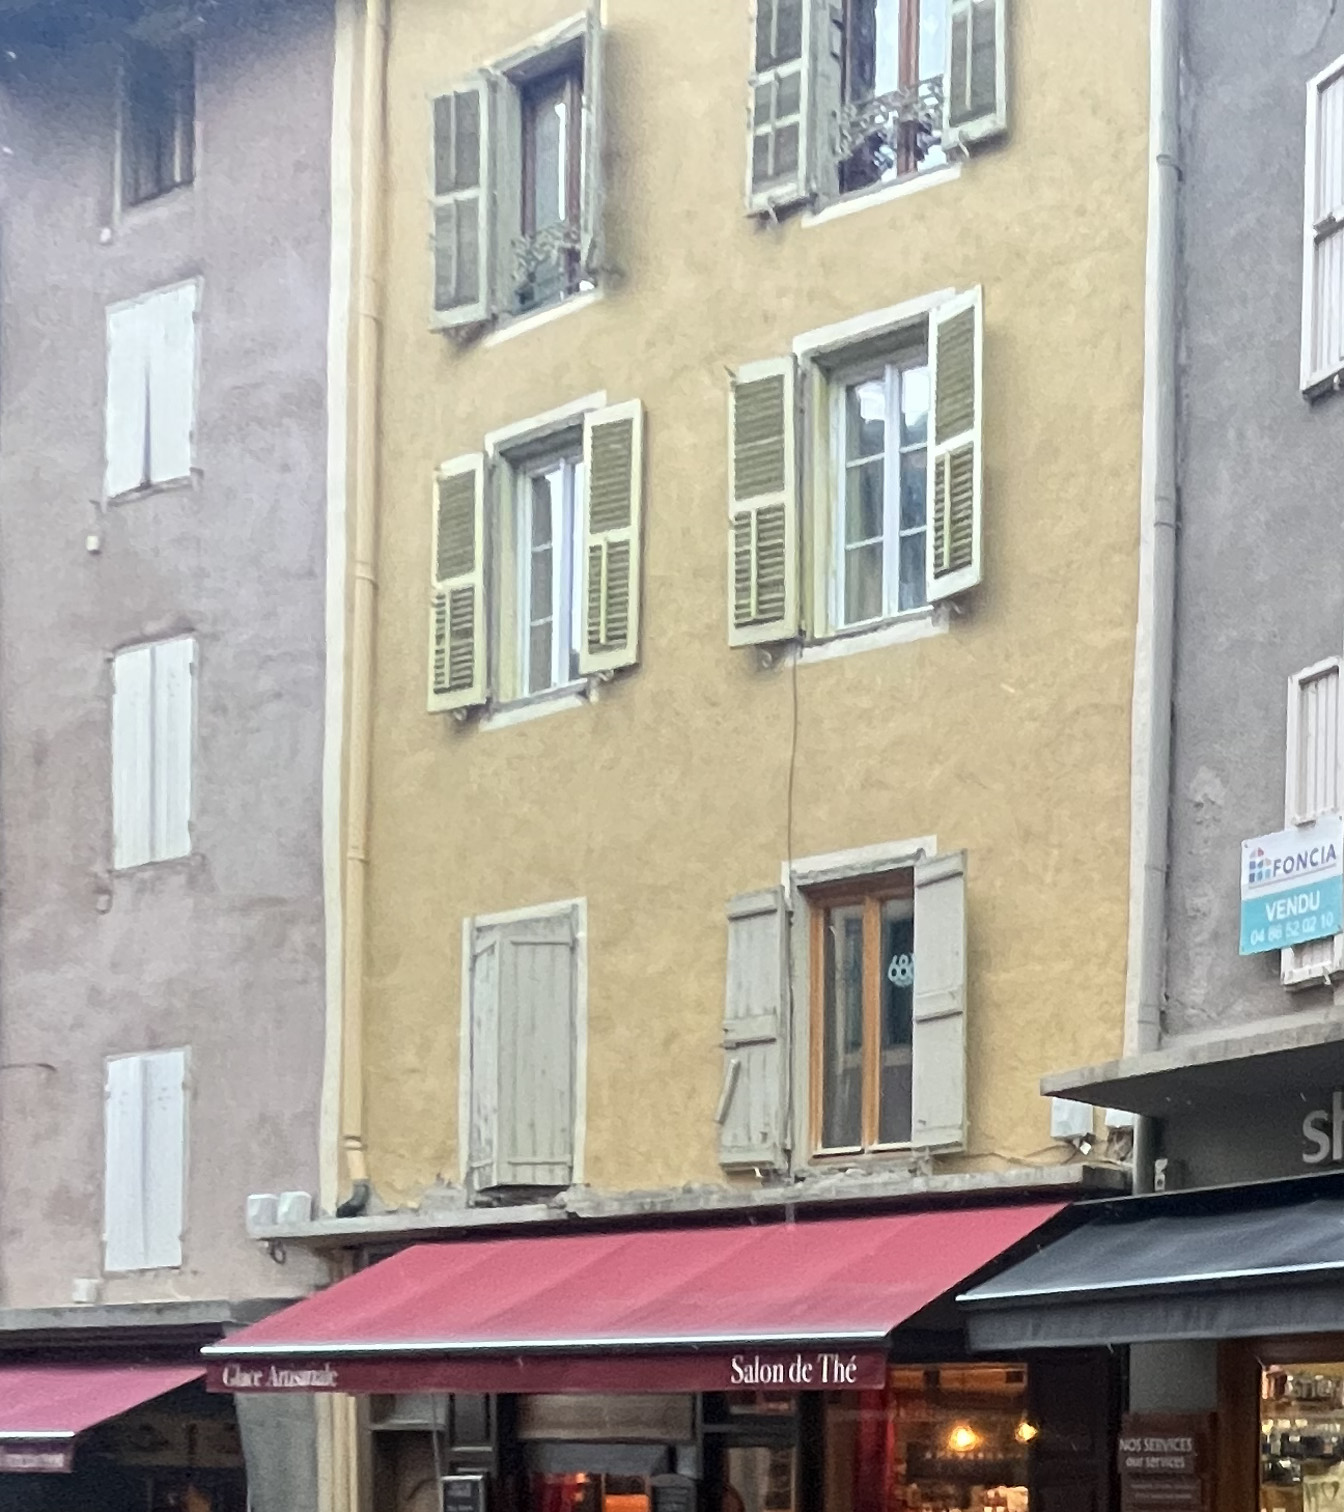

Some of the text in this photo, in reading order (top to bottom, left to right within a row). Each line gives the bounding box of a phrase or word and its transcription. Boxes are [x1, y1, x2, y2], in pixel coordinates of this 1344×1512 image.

[1273, 844, 1336, 877] FONCIA
[1265, 890, 1320, 922] VENDU
[1250, 929, 1265, 945] 04
[1303, 916, 1317, 933] 02
[1321, 912, 1334, 928] 10
[731, 1353, 857, 1384] Salon de Thé
[1119, 1437, 1141, 1452] NOS
